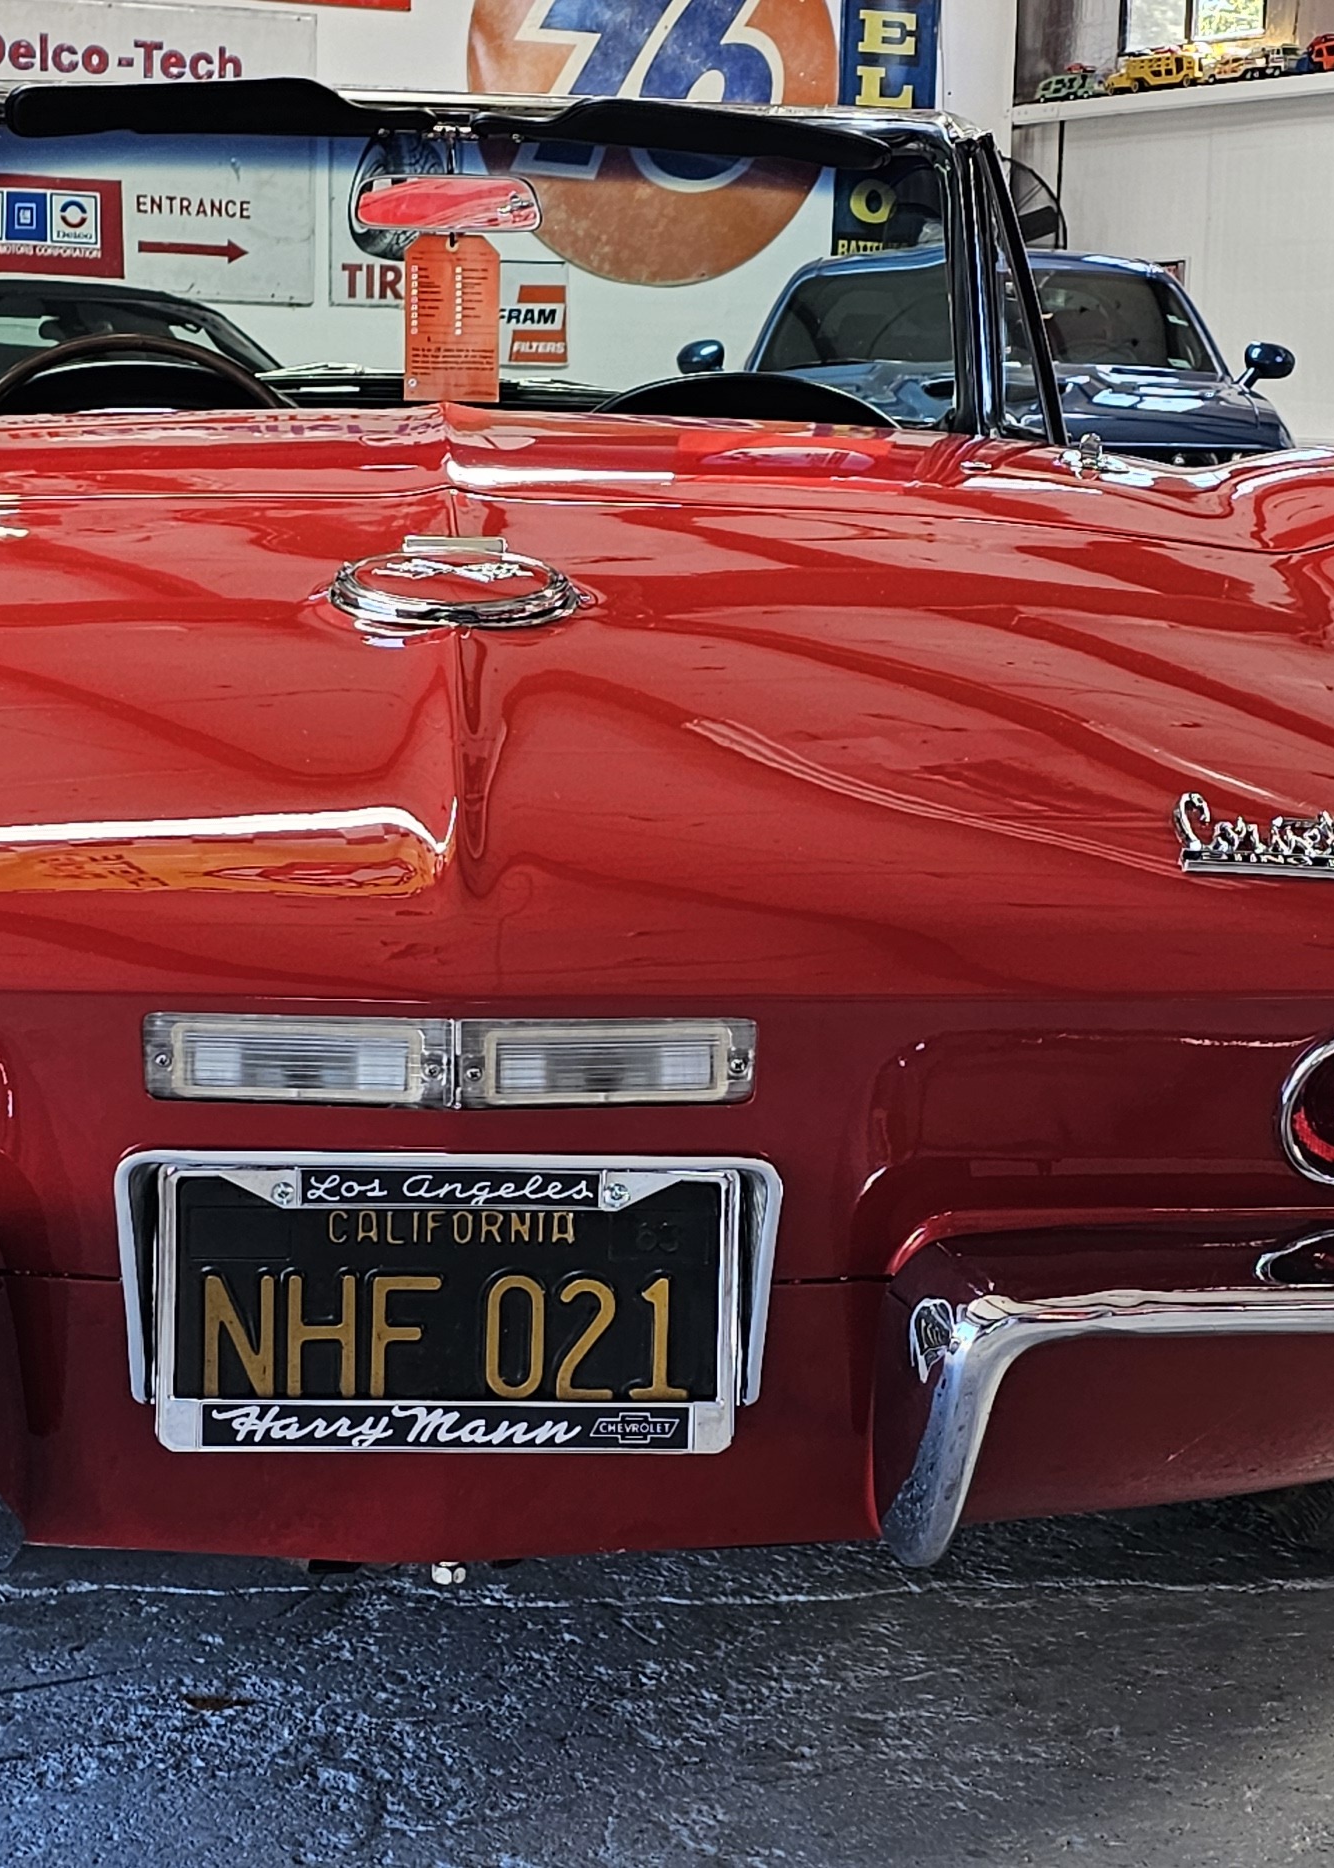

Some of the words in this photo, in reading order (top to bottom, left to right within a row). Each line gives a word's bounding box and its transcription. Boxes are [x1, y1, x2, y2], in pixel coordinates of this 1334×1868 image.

[136, 193, 251, 219] ENTRANCE
[56, 229, 93, 240] Delco
[0, 244, 34, 256] MOTORS
[35, 245, 102, 259] CORPORATION
[499, 308, 557, 325] FRAM
[512, 340, 566, 355] FILTERS
[306, 1174, 388, 1201] Los
[401, 1174, 594, 1206] Angeles
[328, 1210, 576, 1246] CALIFORNIA
[202, 1274, 443, 1398] NHF
[483, 1273, 689, 1400] 021
[211, 1404, 393, 1447] Harry
[389, 1403, 582, 1444] Mann
[598, 1421, 671, 1433] CHEVROLET
